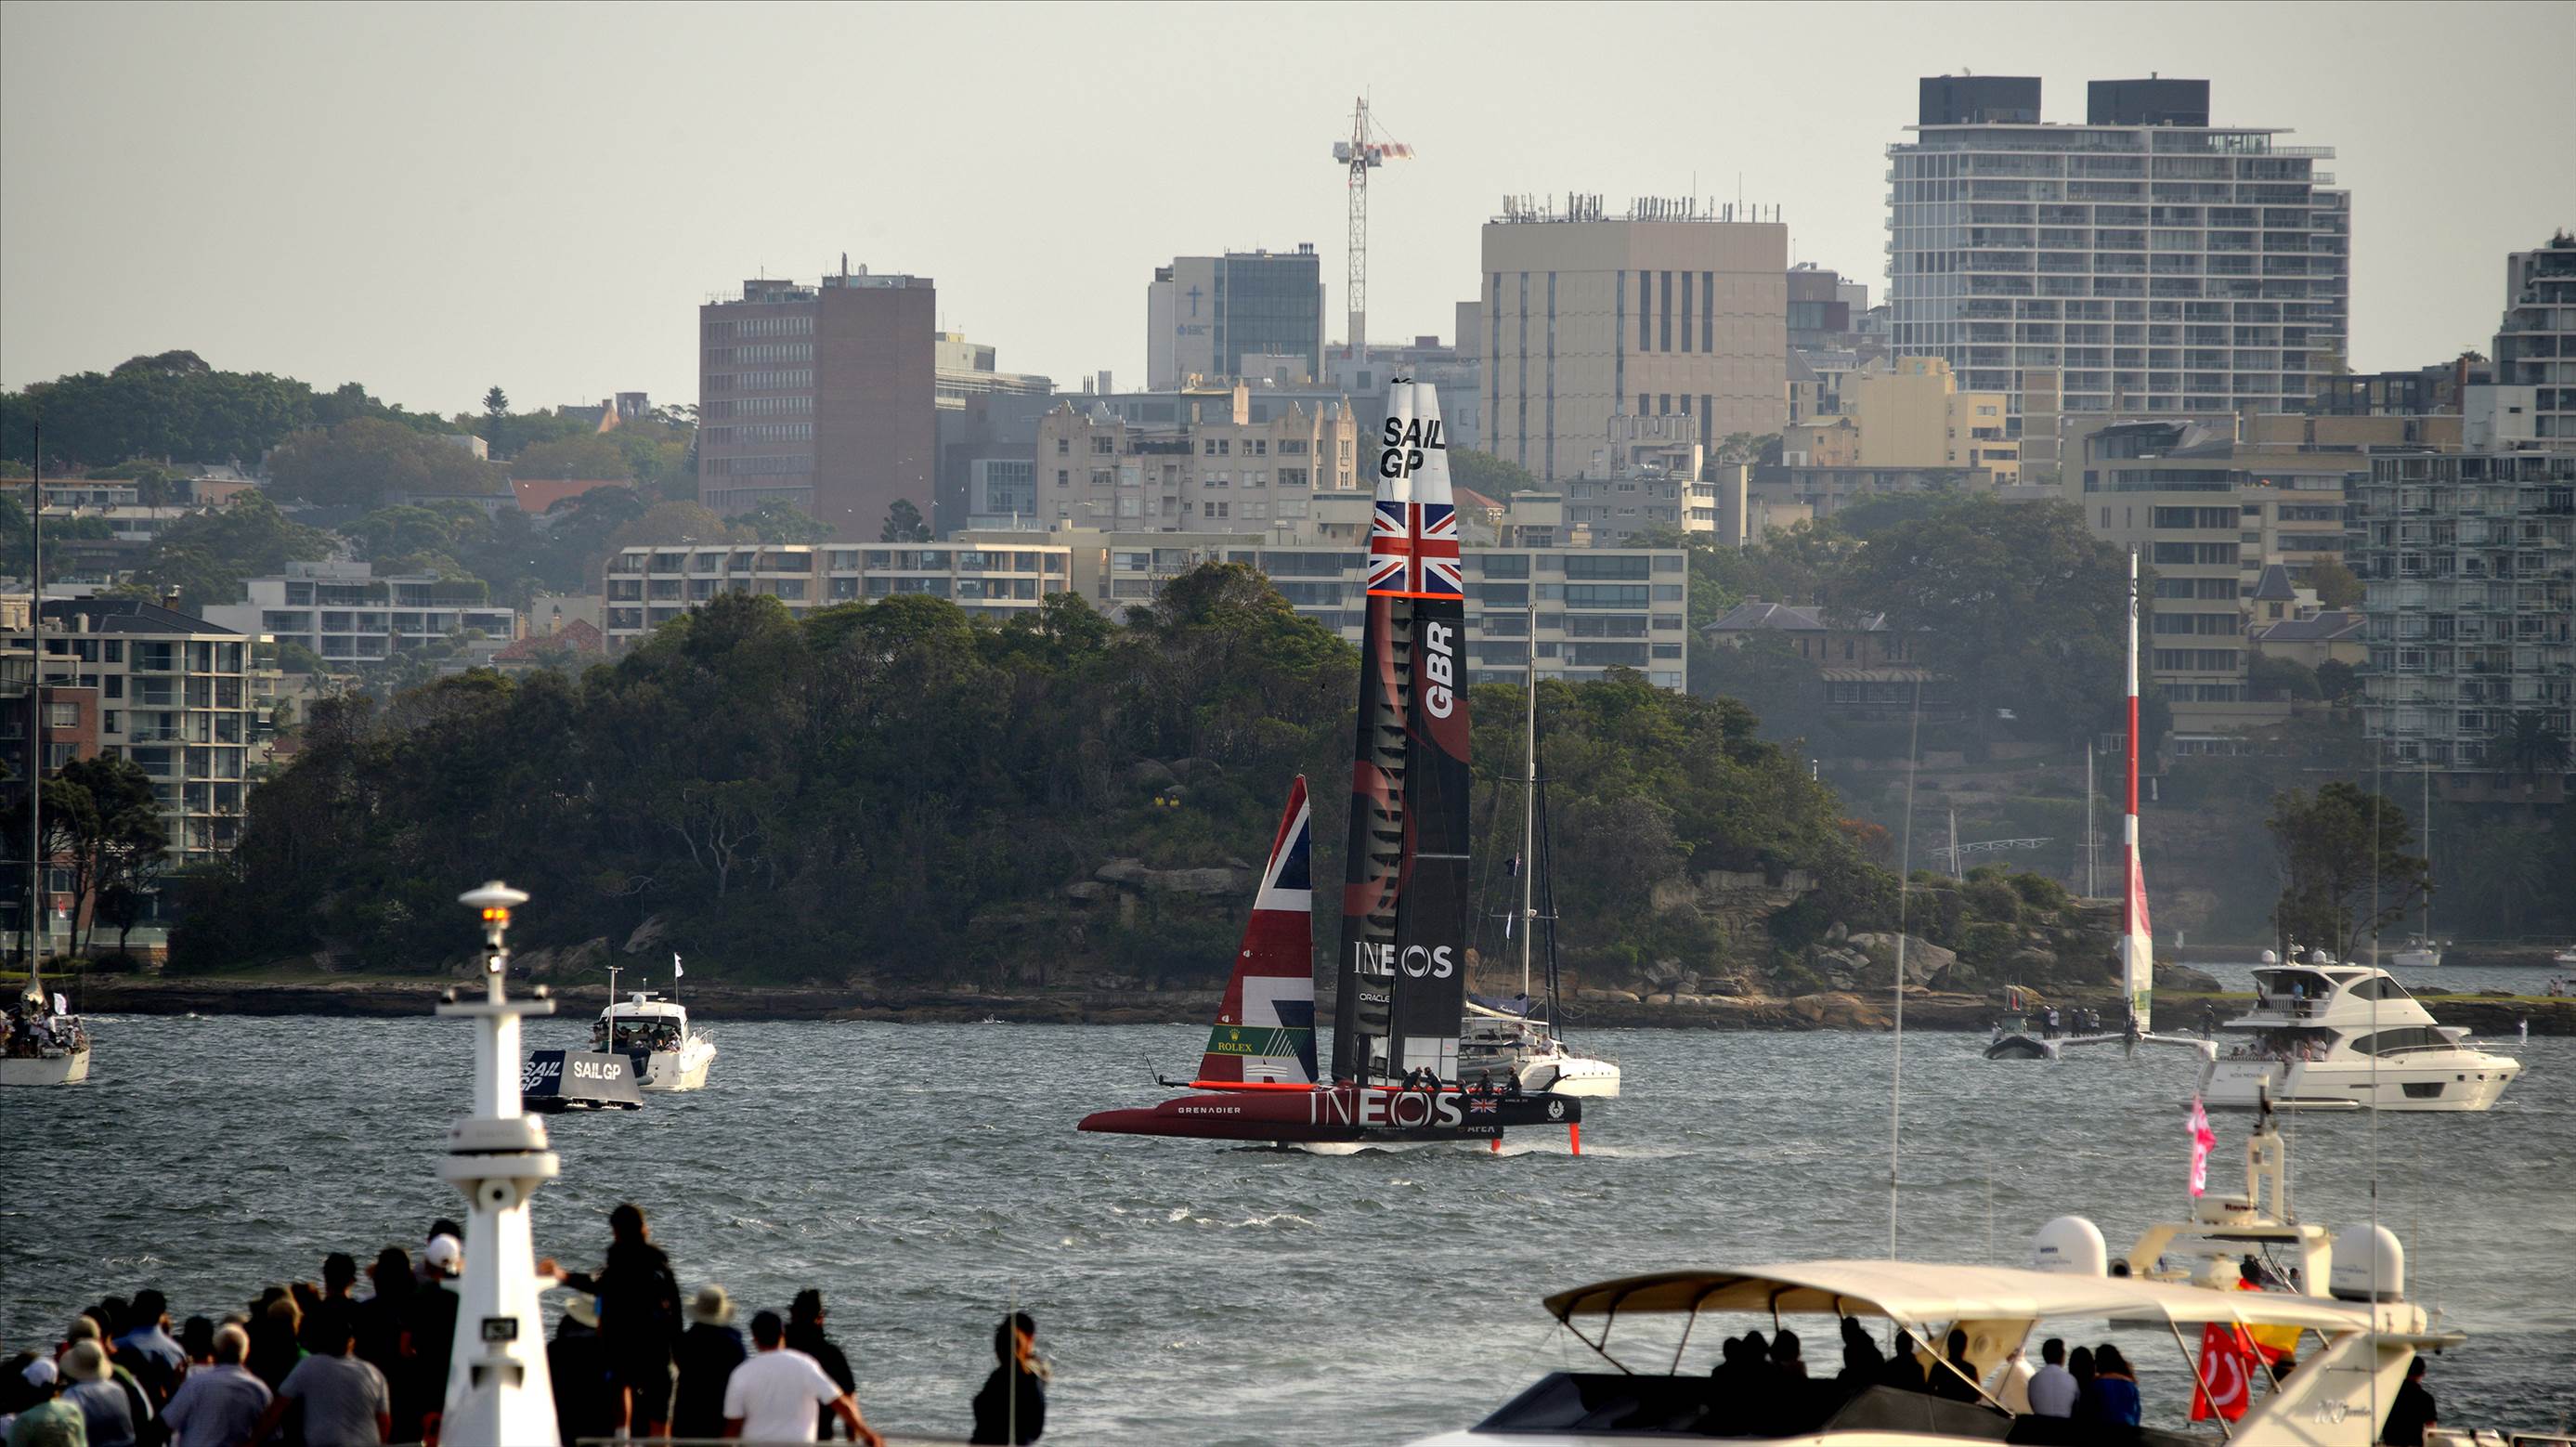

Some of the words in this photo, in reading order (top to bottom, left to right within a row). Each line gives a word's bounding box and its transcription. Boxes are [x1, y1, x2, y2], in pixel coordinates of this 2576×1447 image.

[1383, 417, 1446, 450] SAIL
[1380, 448, 1425, 478] GP
[1425, 621, 1453, 719] GBR
[1353, 941, 1453, 979] INEOS
[1359, 993, 1390, 1003] ORACLE
[1217, 1042, 1253, 1052] ROLEX
[523, 1062, 560, 1076] SAIL
[1308, 1089, 1463, 1128] INEOS
